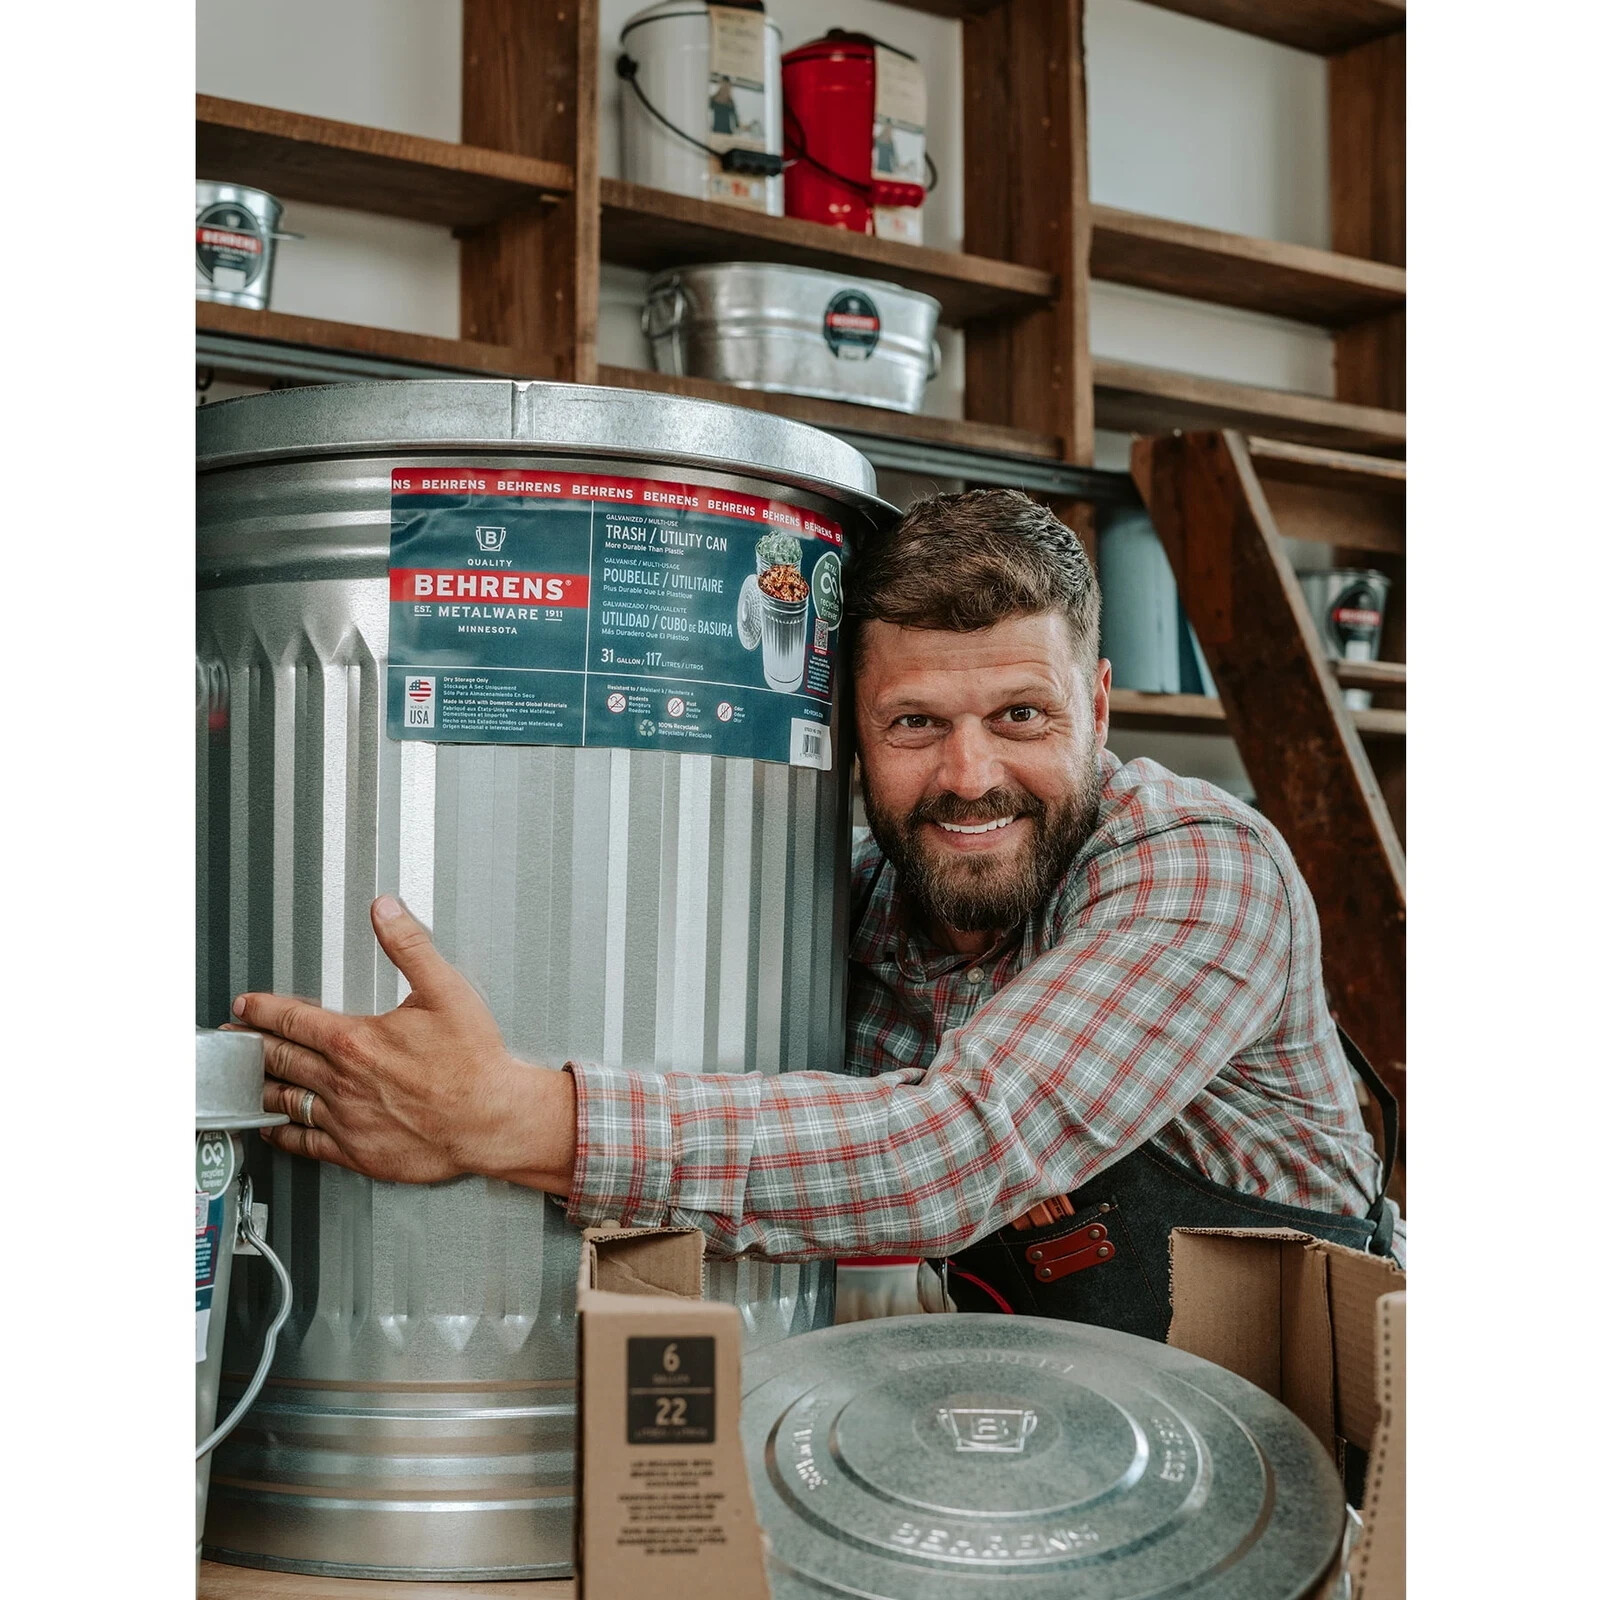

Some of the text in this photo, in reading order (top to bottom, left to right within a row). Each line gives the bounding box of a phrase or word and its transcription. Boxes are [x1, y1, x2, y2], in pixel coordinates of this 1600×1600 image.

[422, 480, 485, 489] BEHRENS
[498, 481, 561, 492] BEHRENS
[572, 485, 633, 498] BEHRENS
[644, 492, 699, 507] BEHRENS
[708, 500, 755, 516] BEHRENS
[763, 510, 800, 527] BEHRENS
[805, 521, 832, 539] BEHRENS
[606, 514, 643, 524] GALVANIZED
[648, 518, 678, 528] MULTI-USE
[486, 531, 497, 544] B
[606, 525, 646, 542] TRASH
[660, 531, 702, 549] UTILITY
[706, 536, 727, 552] CAN
[622, 543, 646, 552] Durable
[648, 545, 663, 553] Than
[664, 547, 684, 556] Plastic
[468, 559, 512, 567] QUALITY
[604, 556, 637, 566] GALVANISÉ
[642, 561, 680, 571] MULTI-USAGE
[603, 568, 659, 587] POUBELLE
[672, 575, 723, 594] UTILITAIRE
[603, 585, 617, 593] Plus
[619, 586, 642, 595] Durable
[644, 588, 655, 598] Que
[666, 591, 692, 600] Plastique
[414, 605, 563, 619] EST. METALWARE 1911
[602, 600, 644, 610] GALVANIZADO
[650, 604, 687, 614] POLIVALENTE
[458, 626, 518, 635] MINNESOTA
[602, 611, 649, 628] UTILIDAD
[660, 616, 687, 632] CUBO
[689, 624, 696, 633] DE
[698, 620, 733, 638] BASURA
[616, 629, 645, 638] Duradero
[666, 633, 689, 642] Plástico
[601, 648, 614, 663] 31
[616, 657, 641, 665] GALLON
[646, 652, 662, 666] 117
[410, 710, 429, 724] USA
[674, 723, 699, 731] Recyclable
[663, 1343, 680, 1372] 6
[656, 1398, 687, 1425] 22
